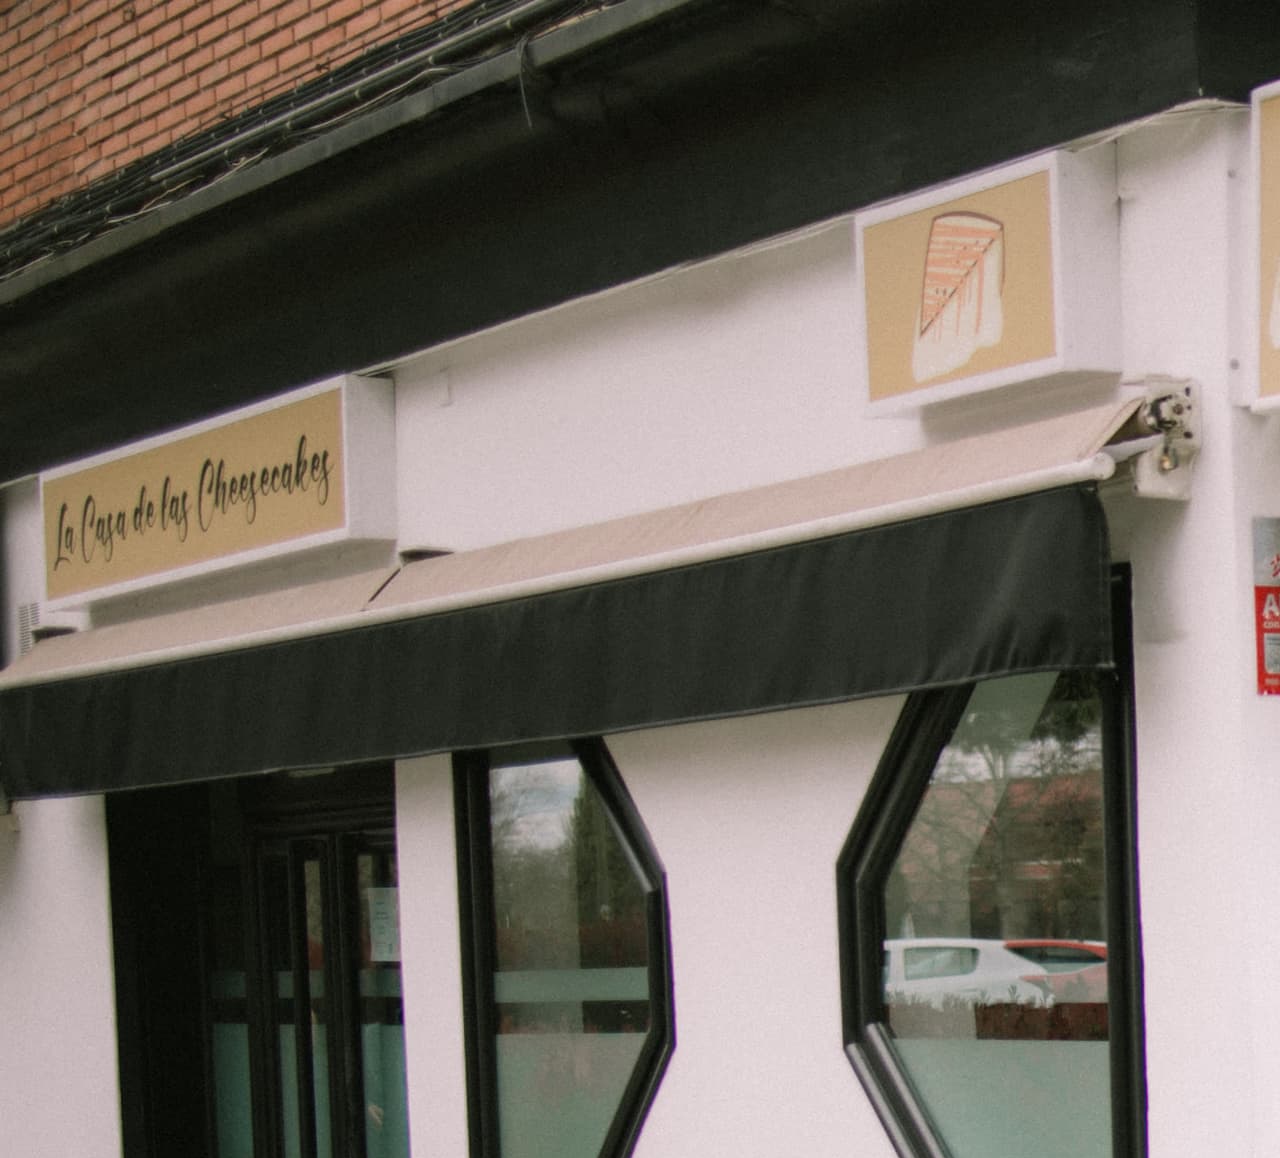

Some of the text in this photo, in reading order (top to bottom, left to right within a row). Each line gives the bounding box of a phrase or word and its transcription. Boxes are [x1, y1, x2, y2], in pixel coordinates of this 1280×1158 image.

[54, 434, 335, 571] La Casa de las Cheesecakes
